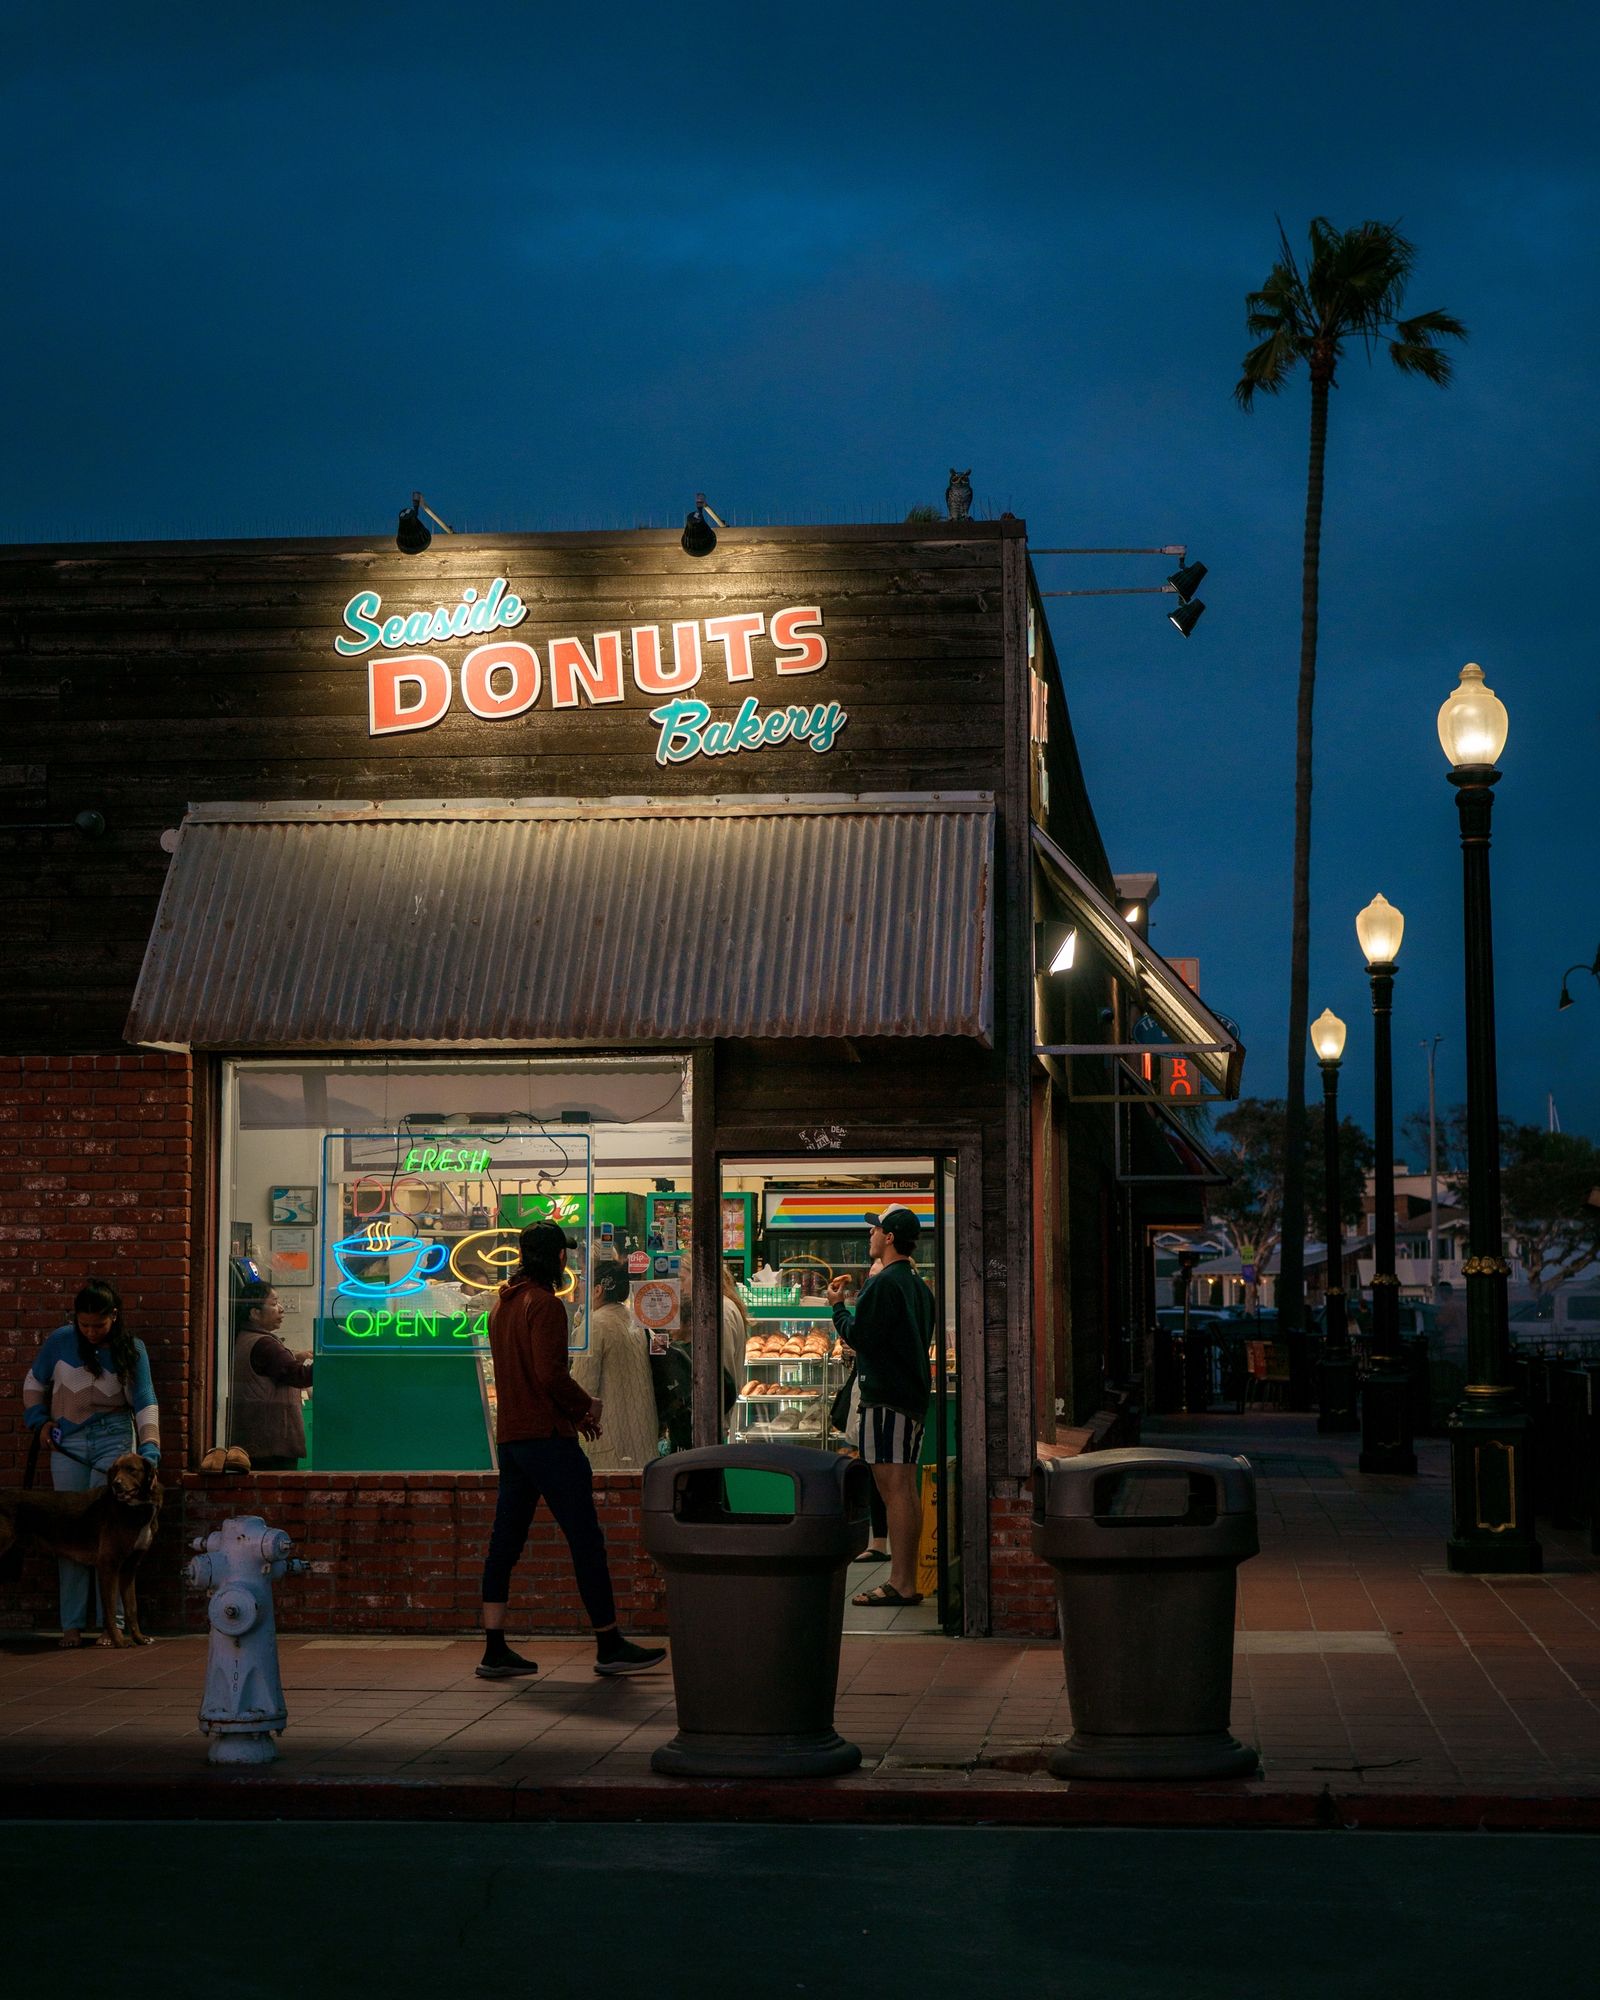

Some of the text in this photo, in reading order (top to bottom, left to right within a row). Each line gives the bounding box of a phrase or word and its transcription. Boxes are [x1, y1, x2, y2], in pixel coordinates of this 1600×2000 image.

[334, 577, 529, 657] Seaside
[367, 605, 828, 737] DONUTS
[650, 696, 848, 766] Bakery
[404, 1148, 491, 1174] FRESH
[352, 1177, 558, 1217] DONUTS
[879, 1180, 919, 1190] Shop Light
[346, 1309, 489, 1338] OPEN 24
